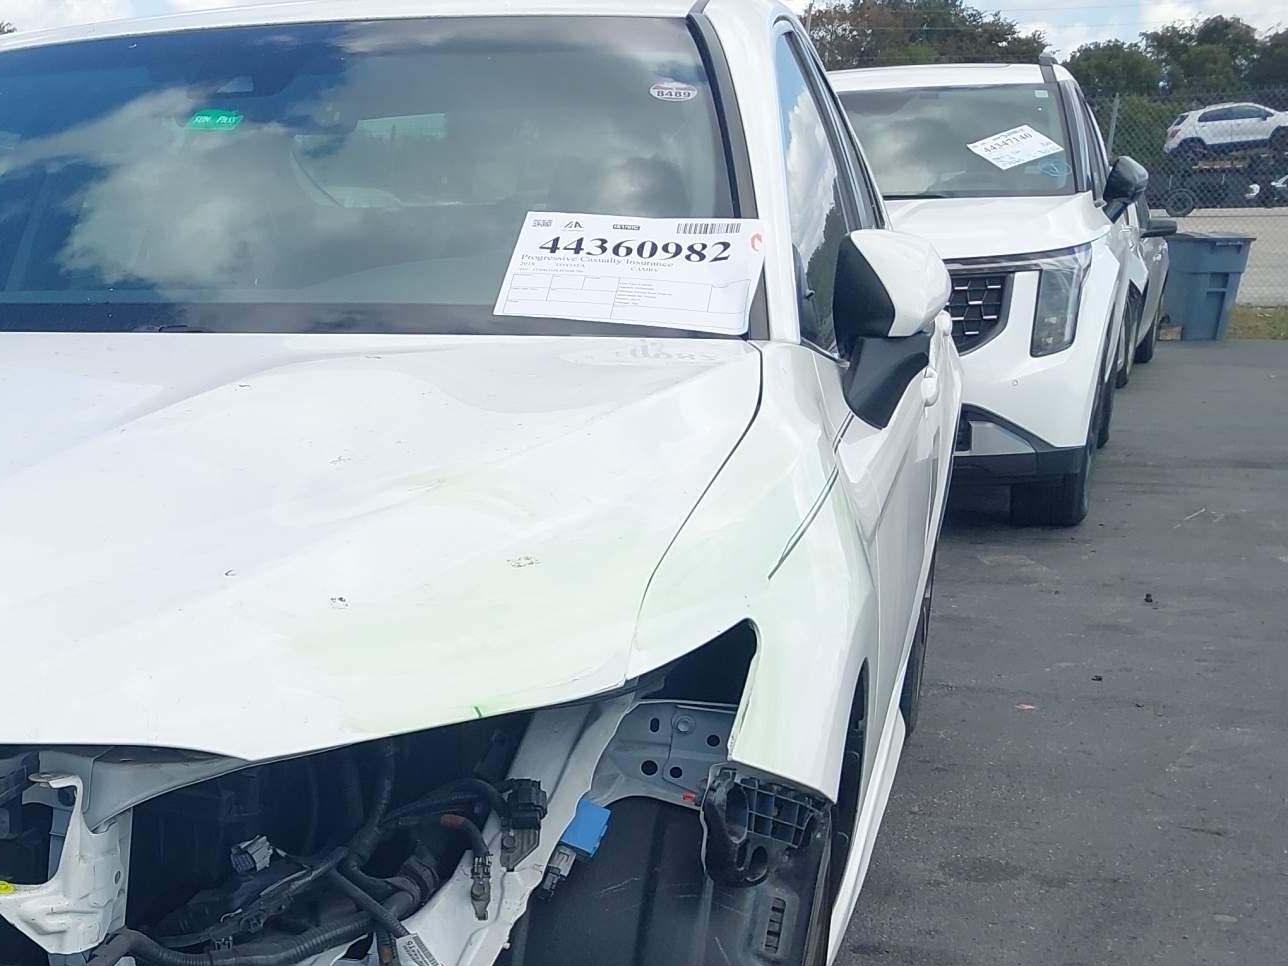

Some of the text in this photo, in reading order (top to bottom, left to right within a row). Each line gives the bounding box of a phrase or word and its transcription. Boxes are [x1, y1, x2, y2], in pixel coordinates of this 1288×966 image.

[539, 236, 731, 263] 44360982
[521, 254, 673, 268] Progressive Casualty Insurance
